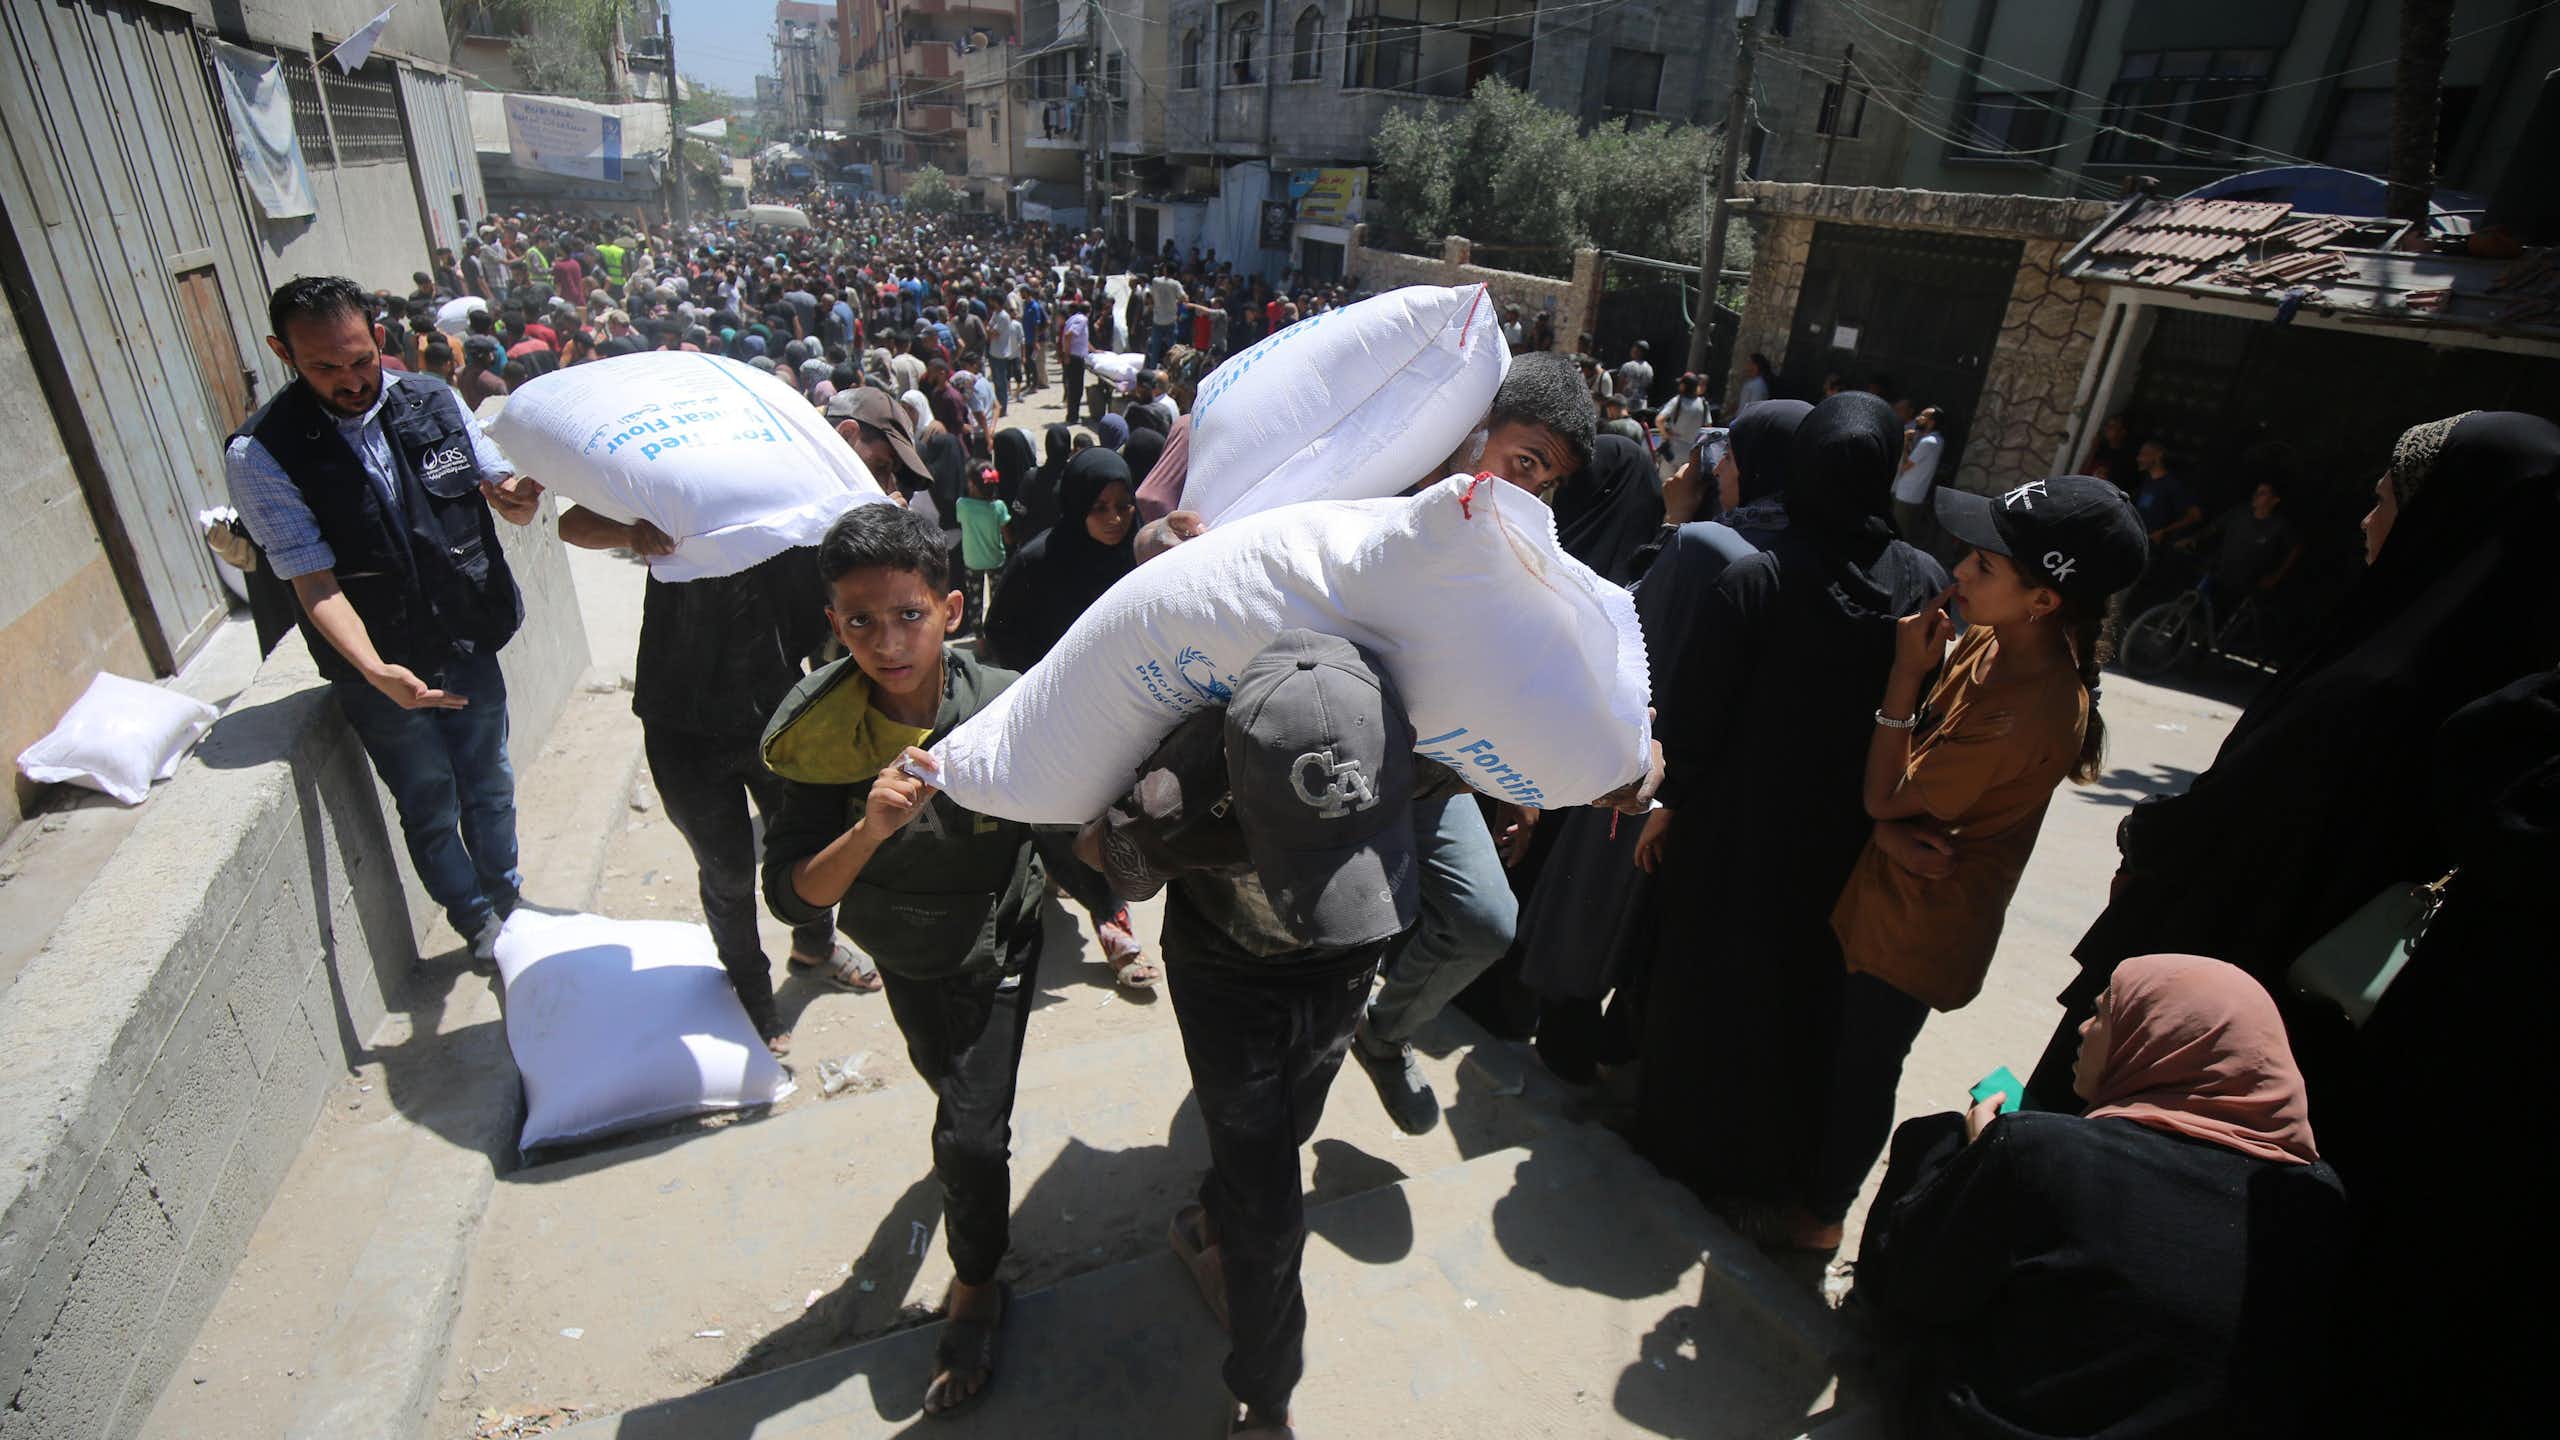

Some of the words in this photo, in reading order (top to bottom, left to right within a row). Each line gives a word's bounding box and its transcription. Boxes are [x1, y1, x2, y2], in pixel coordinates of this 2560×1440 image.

[438, 447, 463, 465] CRS
[605, 417, 671, 456] Flour
[1147, 659, 1193, 705] World
